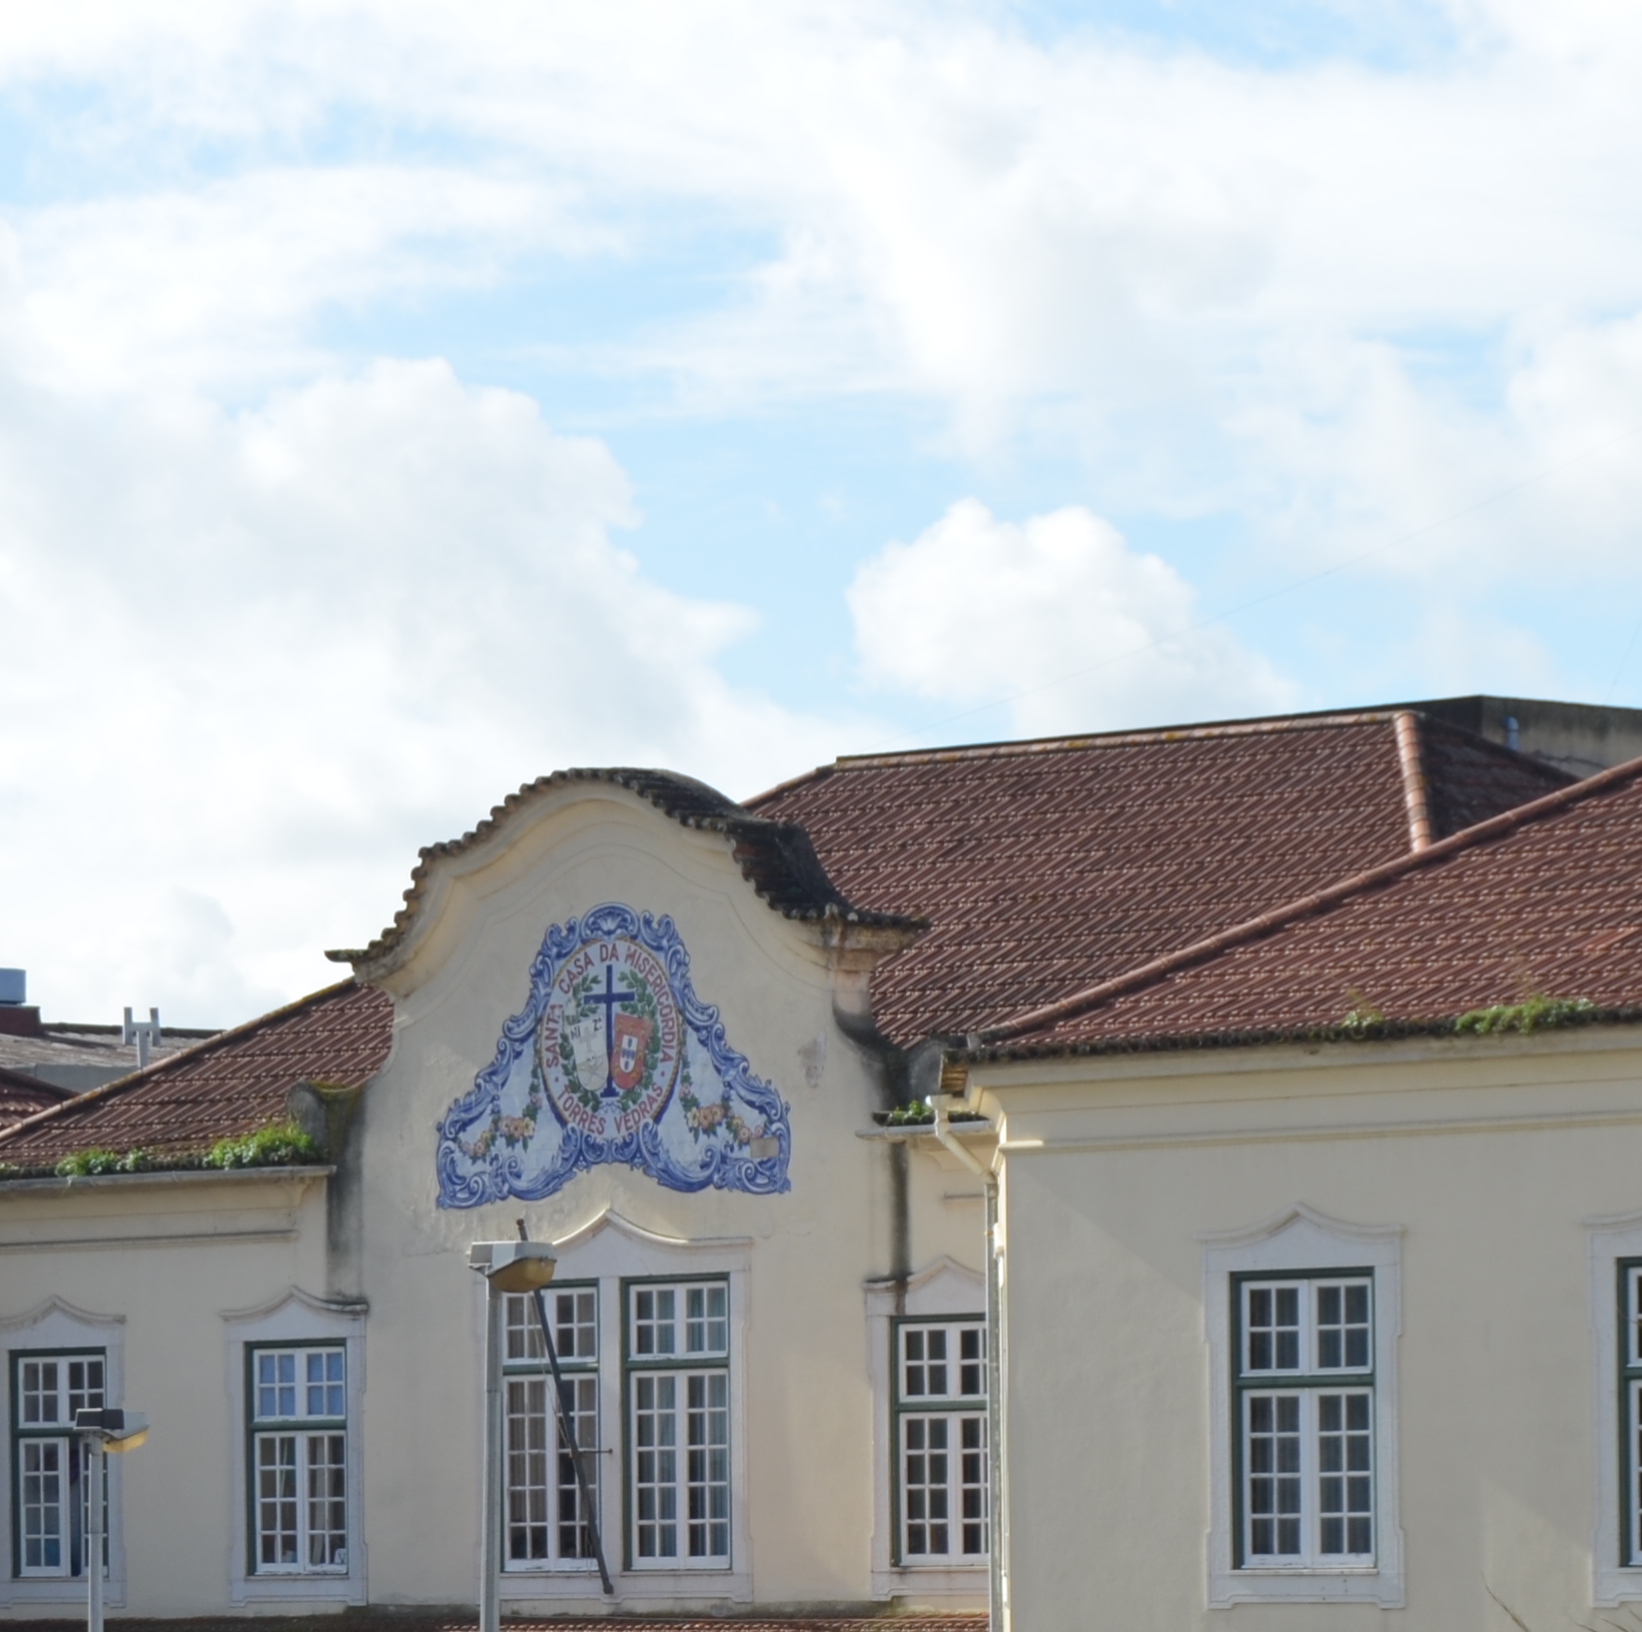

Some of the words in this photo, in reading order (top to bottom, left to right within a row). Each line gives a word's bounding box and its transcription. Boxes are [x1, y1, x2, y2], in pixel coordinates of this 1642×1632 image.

[558, 951, 595, 995] CASA
[599, 944, 619, 962] DA
[624, 945, 676, 1063] MISERICORDIA
[557, 1083, 606, 1135] TORRES
[613, 1084, 663, 1134] VEDRAS
